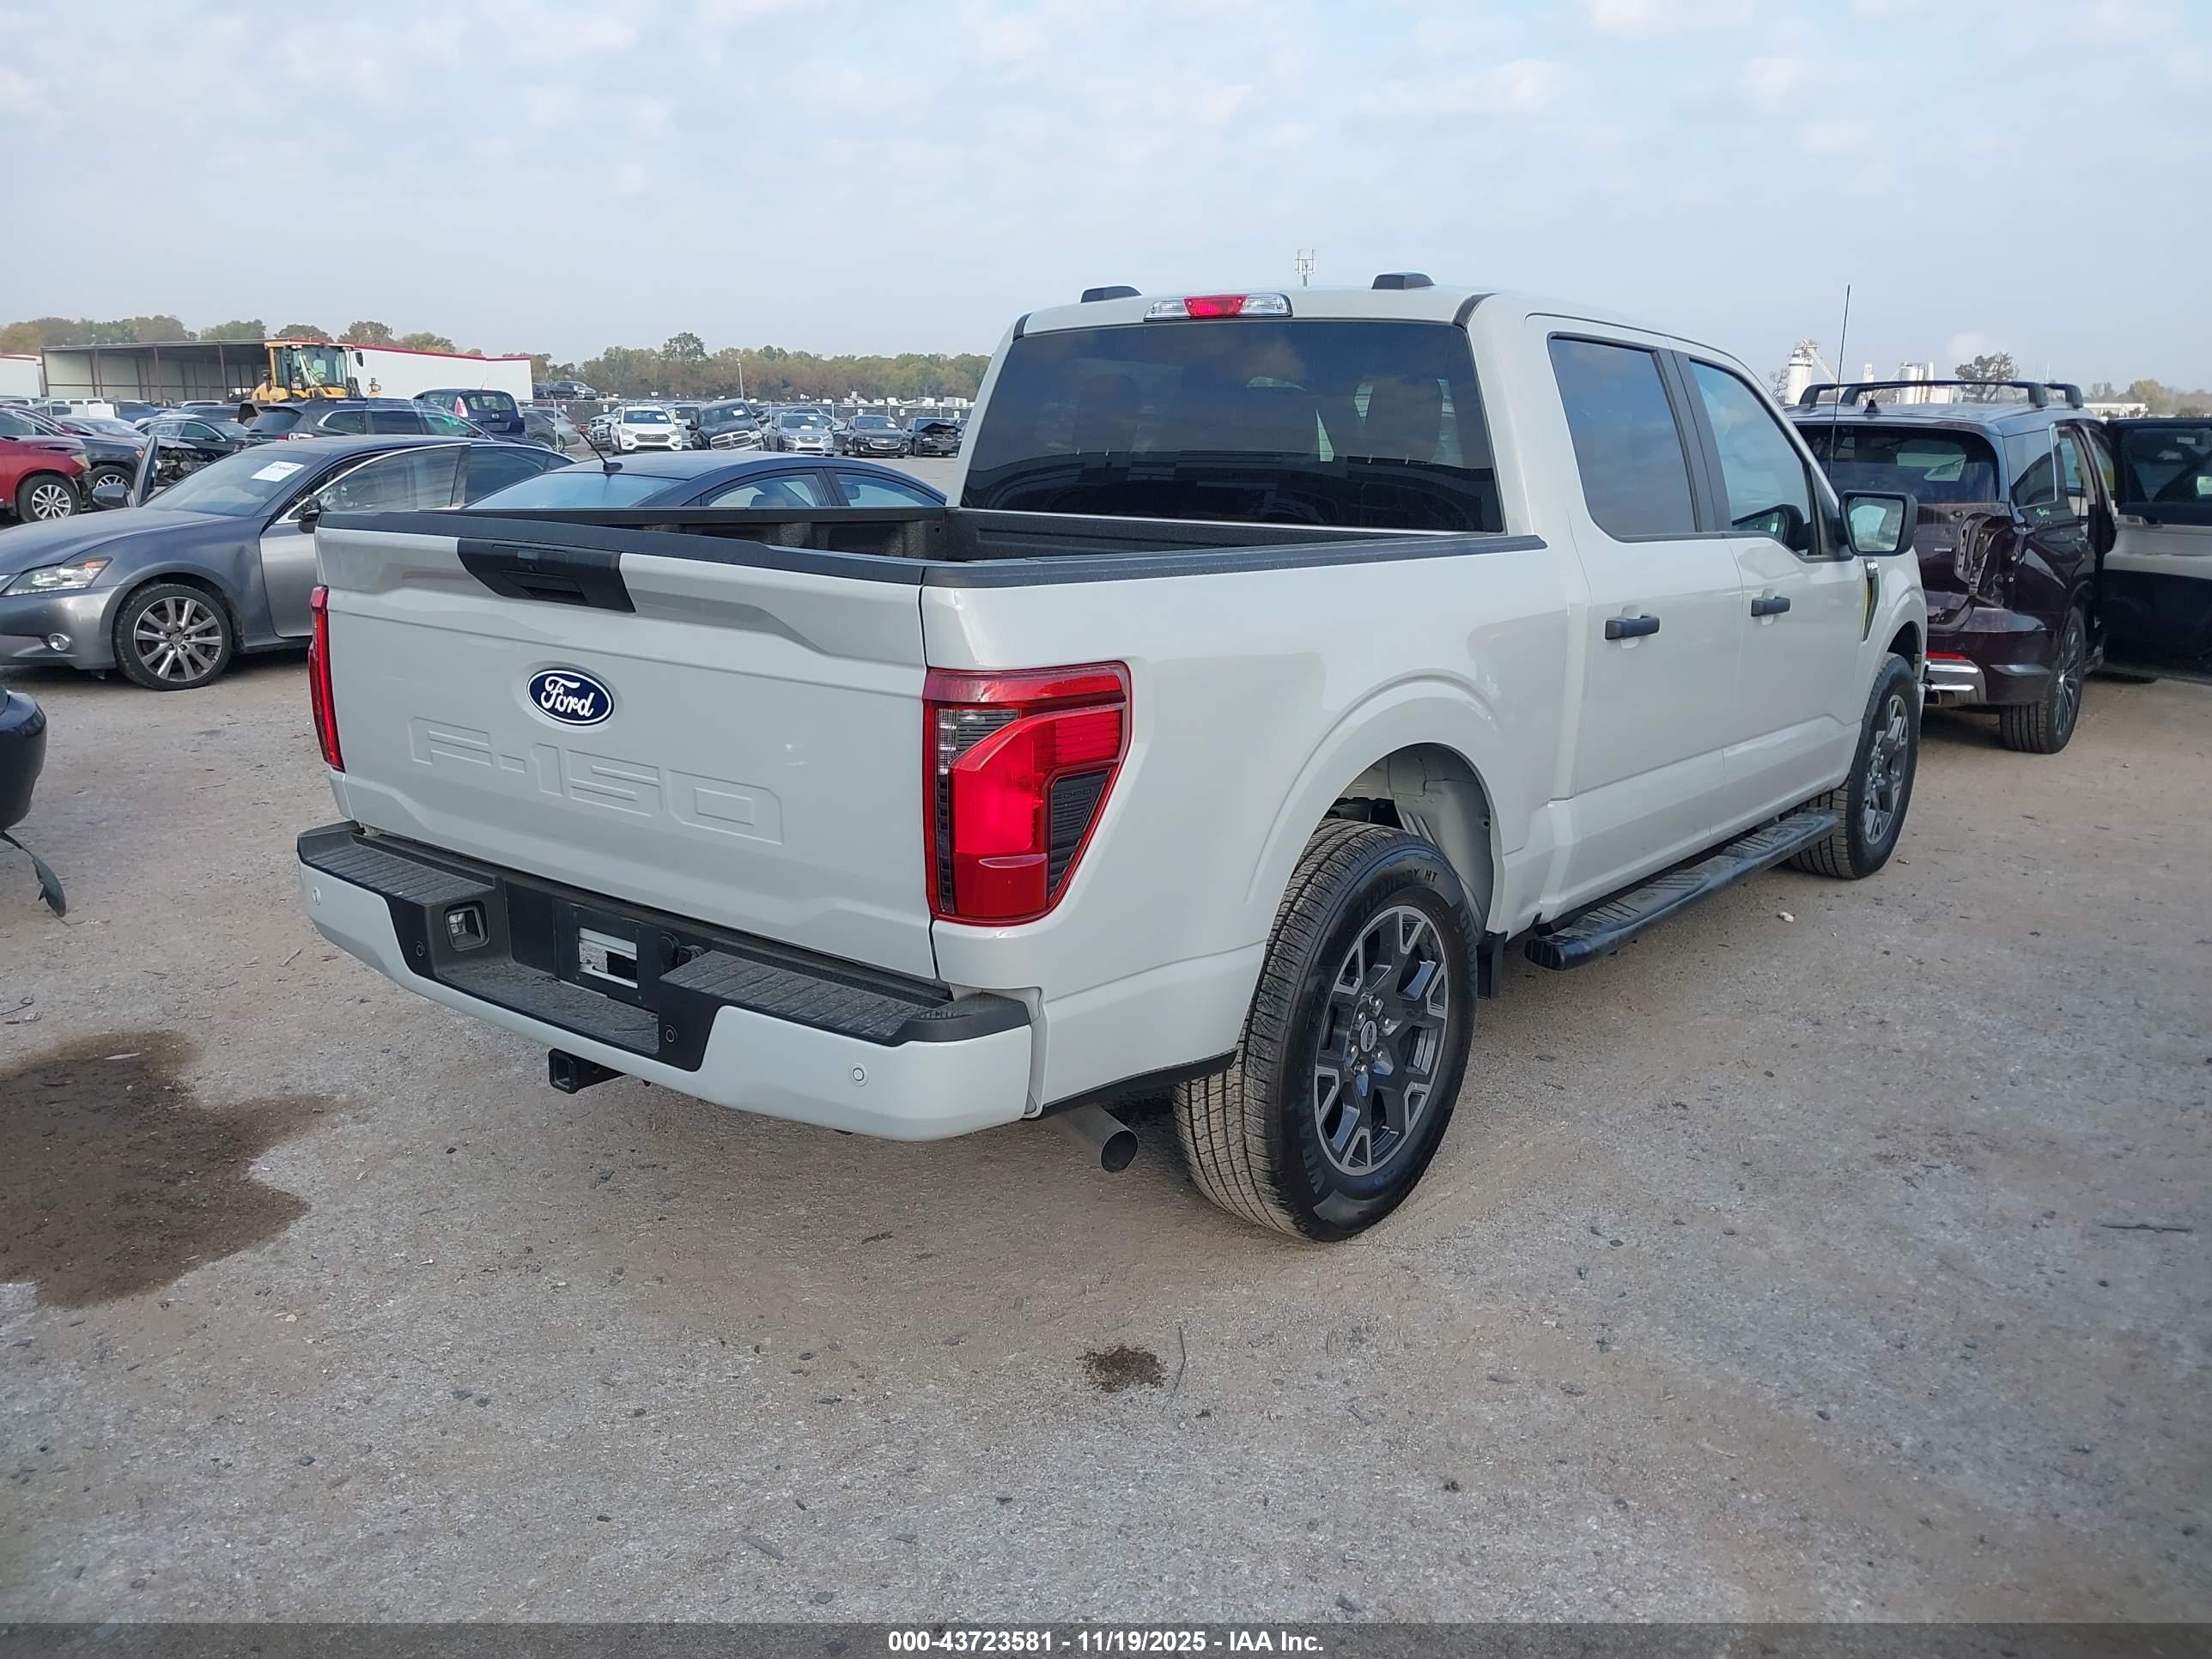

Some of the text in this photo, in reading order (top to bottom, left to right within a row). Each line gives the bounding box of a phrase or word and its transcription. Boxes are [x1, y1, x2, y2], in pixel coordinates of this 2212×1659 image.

[541, 675, 595, 717] Ford
[407, 716, 784, 845] F-150
[1424, 869, 1439, 883] HT
